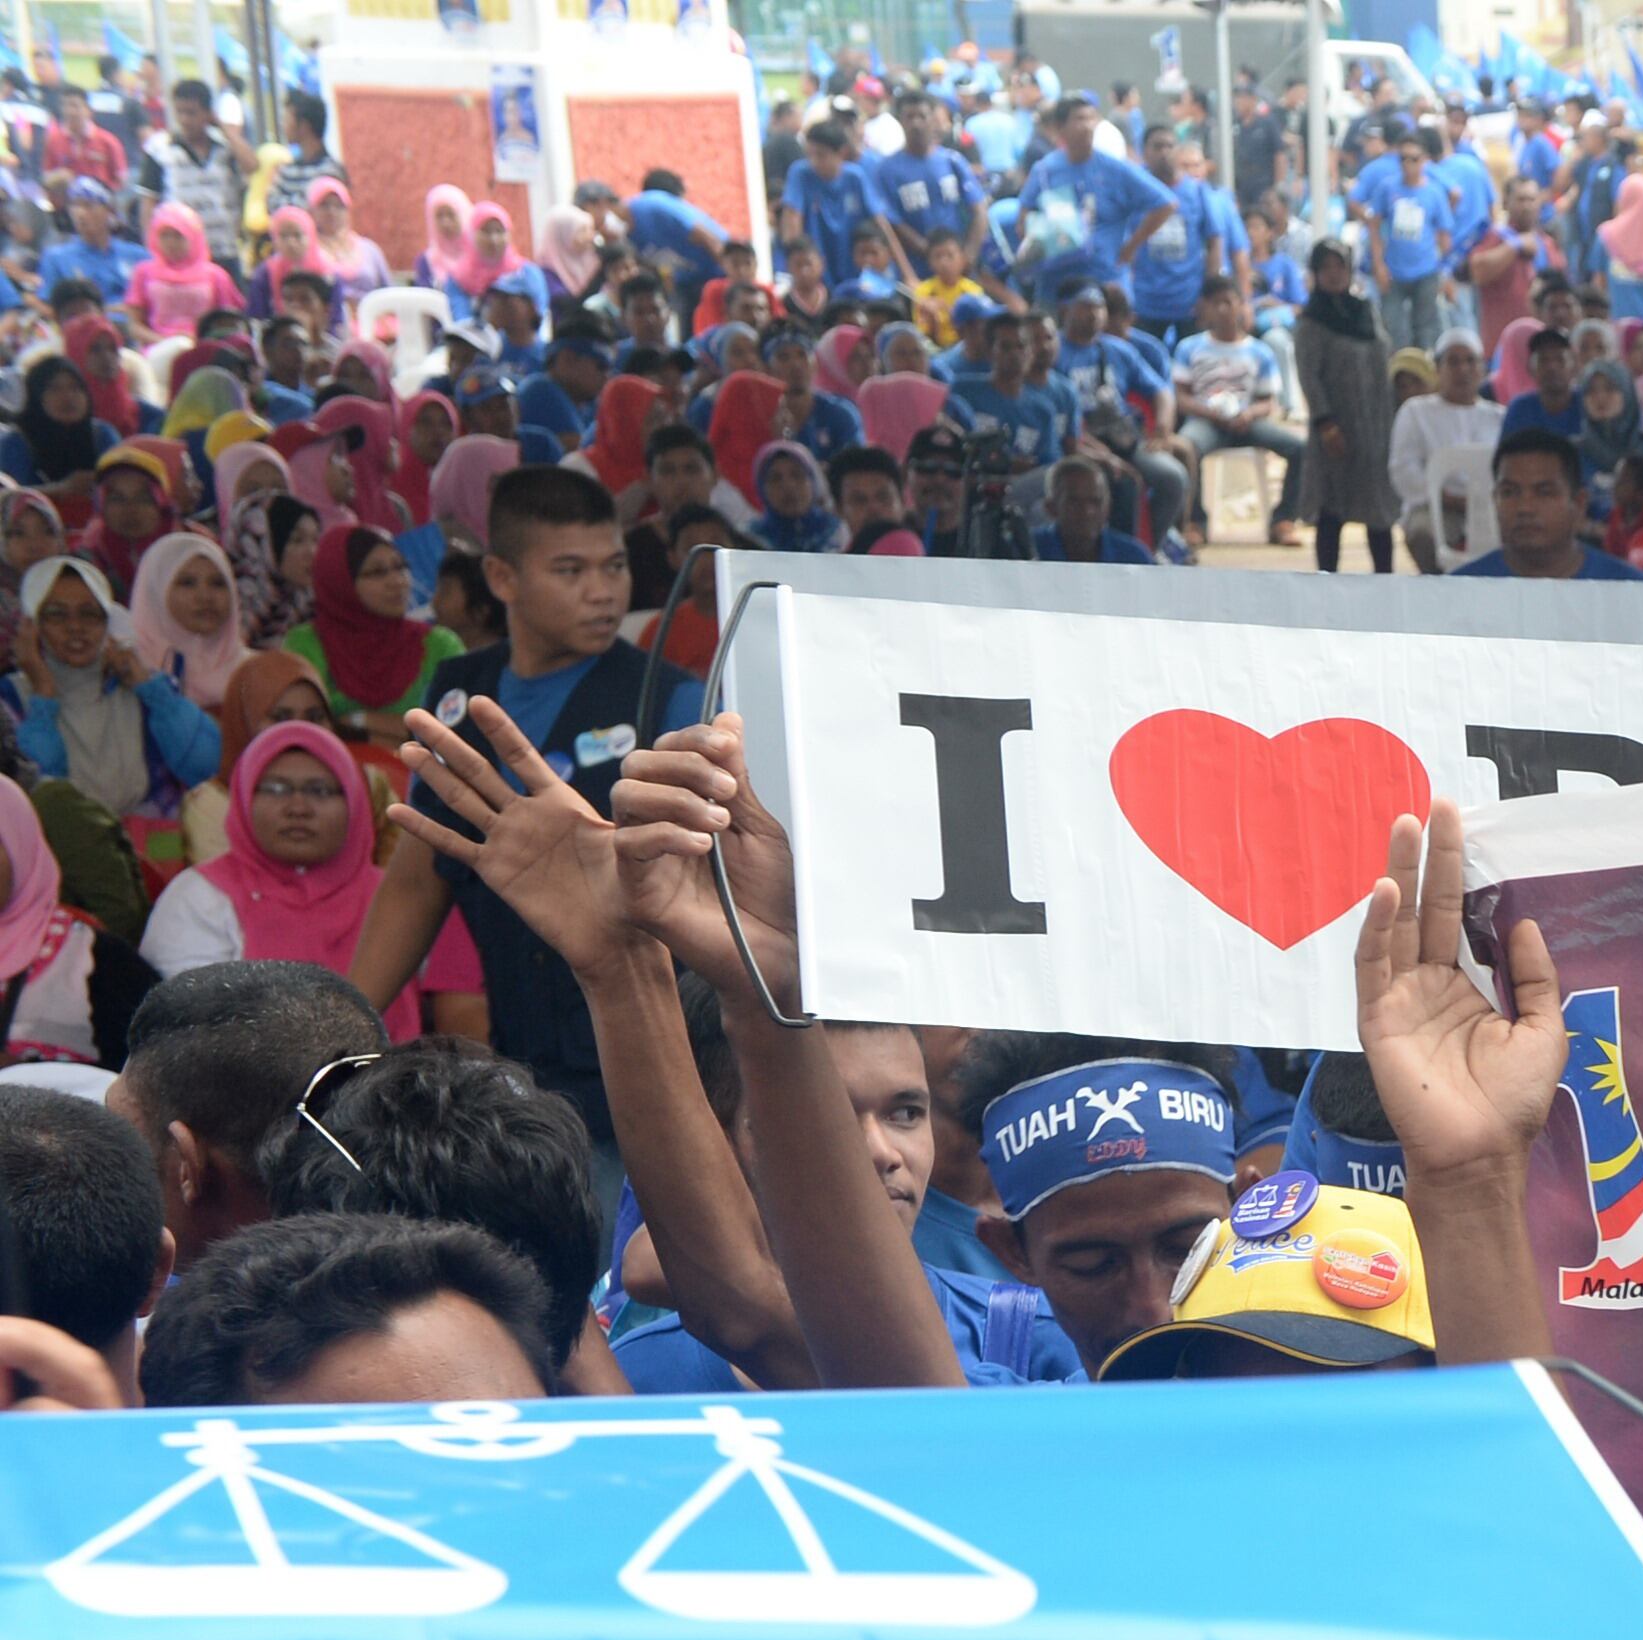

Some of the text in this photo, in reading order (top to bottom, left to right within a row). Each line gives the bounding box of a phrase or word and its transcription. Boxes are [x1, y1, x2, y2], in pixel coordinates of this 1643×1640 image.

[898, 692, 1048, 935] I
[995, 1088, 1225, 1163] TUAH BIRU
